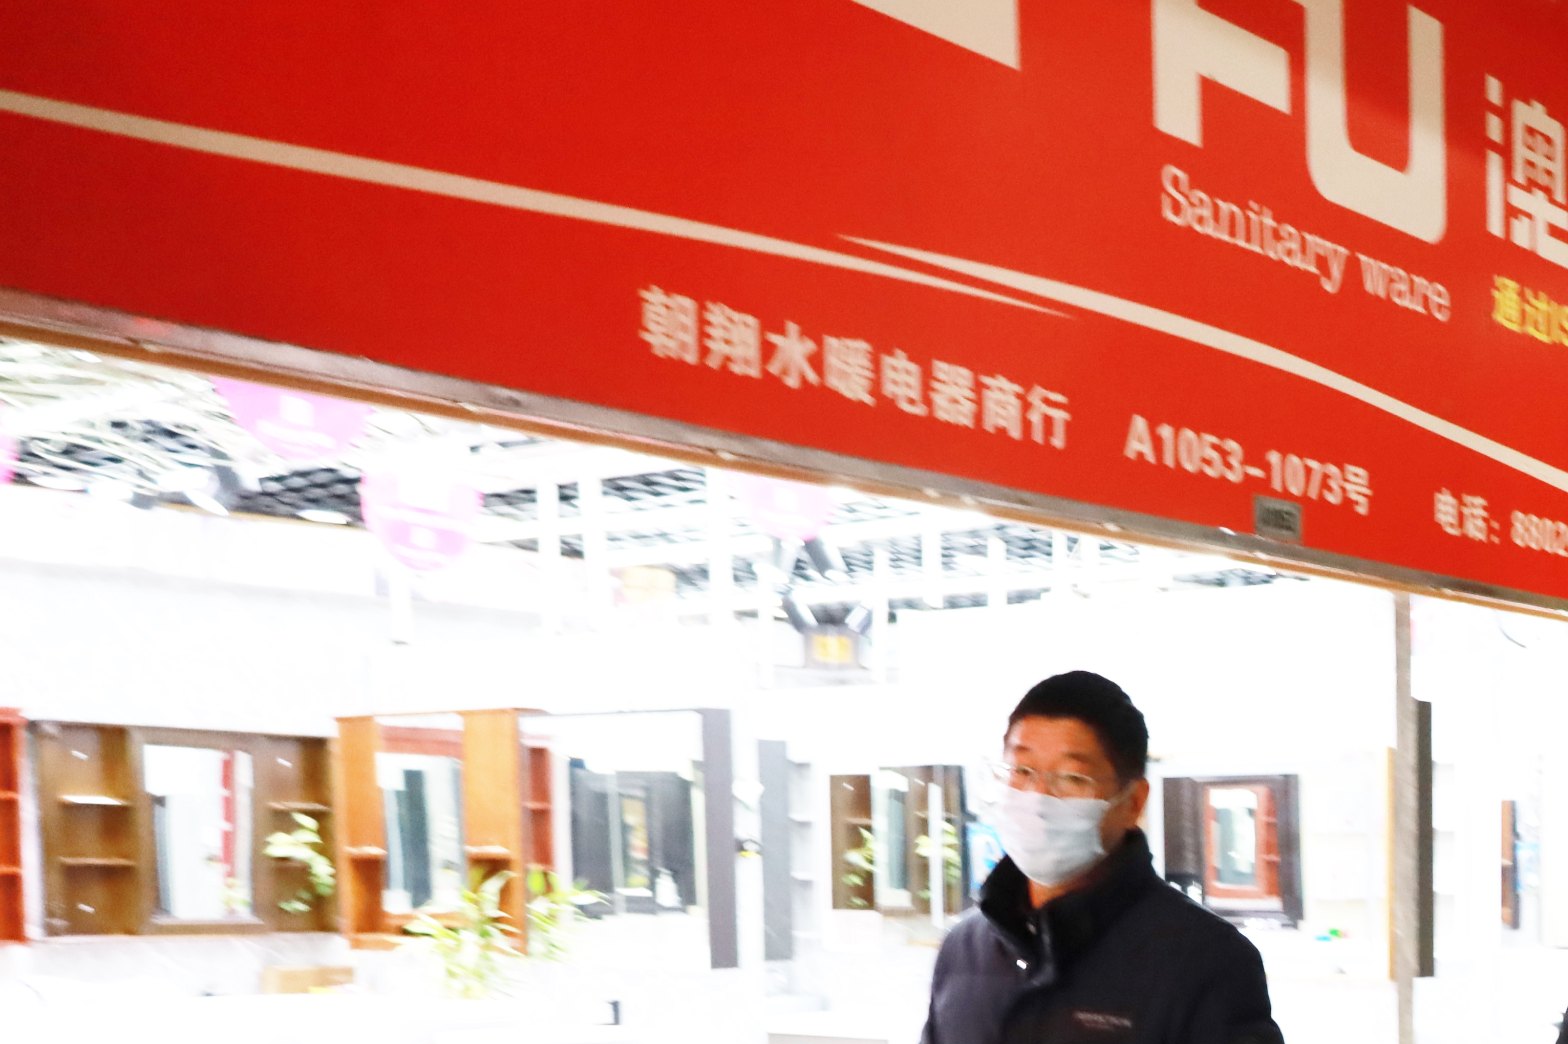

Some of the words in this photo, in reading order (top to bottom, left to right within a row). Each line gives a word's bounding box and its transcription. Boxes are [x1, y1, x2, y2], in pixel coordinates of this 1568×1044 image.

[1160, 163, 1350, 294] Sanitary
[1354, 251, 1451, 323] ware
[637, 284, 1071, 450] 朝翔水暖电器商行
[1123, 413, 1373, 516] A1053-1073号
